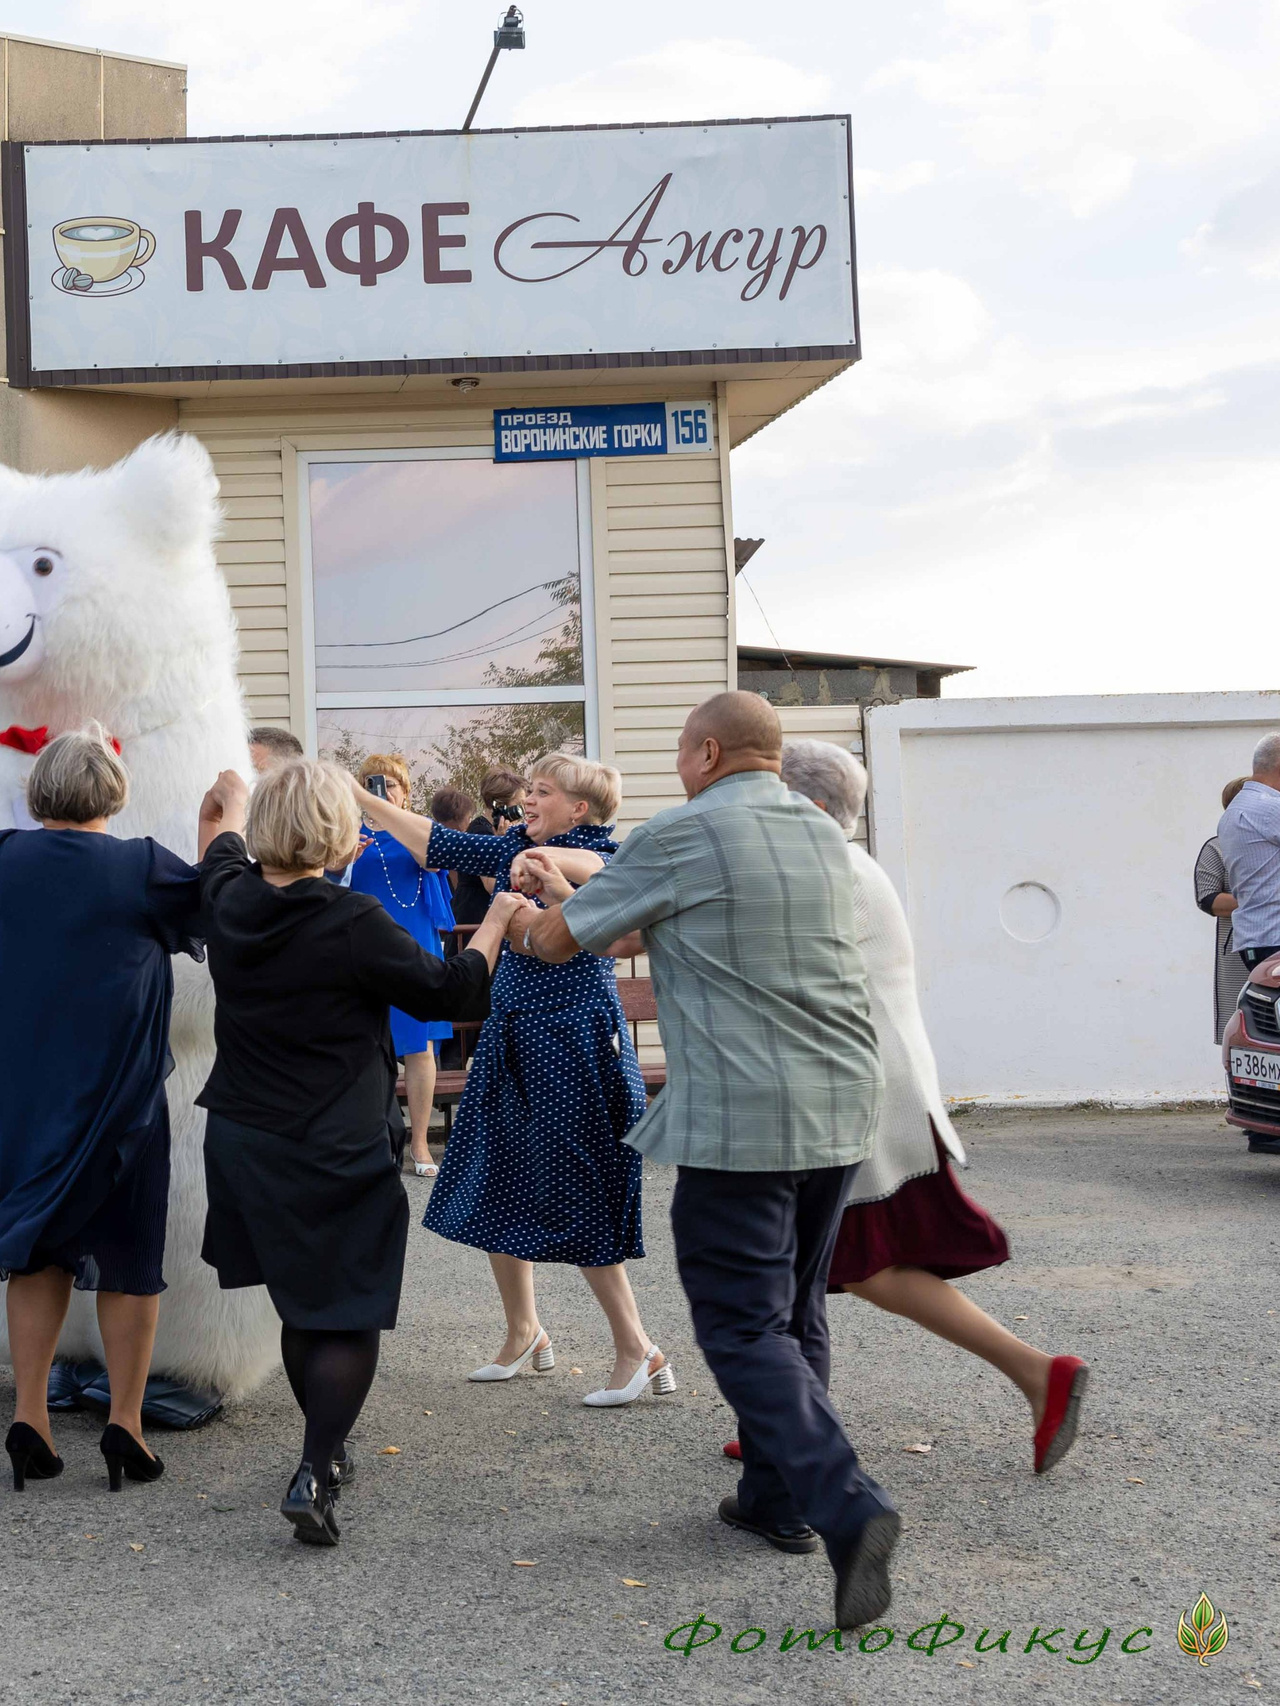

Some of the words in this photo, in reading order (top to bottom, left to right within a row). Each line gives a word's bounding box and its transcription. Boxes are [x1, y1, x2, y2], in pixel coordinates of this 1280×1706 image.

[184, 201, 473, 292] КАФЕ
[493, 172, 827, 301] Ажур
[501, 412, 572, 426] ПРОЕЗД
[671, 409, 708, 445] 156
[501, 426, 608, 453] ВОРОНИНСКИЕ
[613, 423, 662, 448] ГОРКИ
